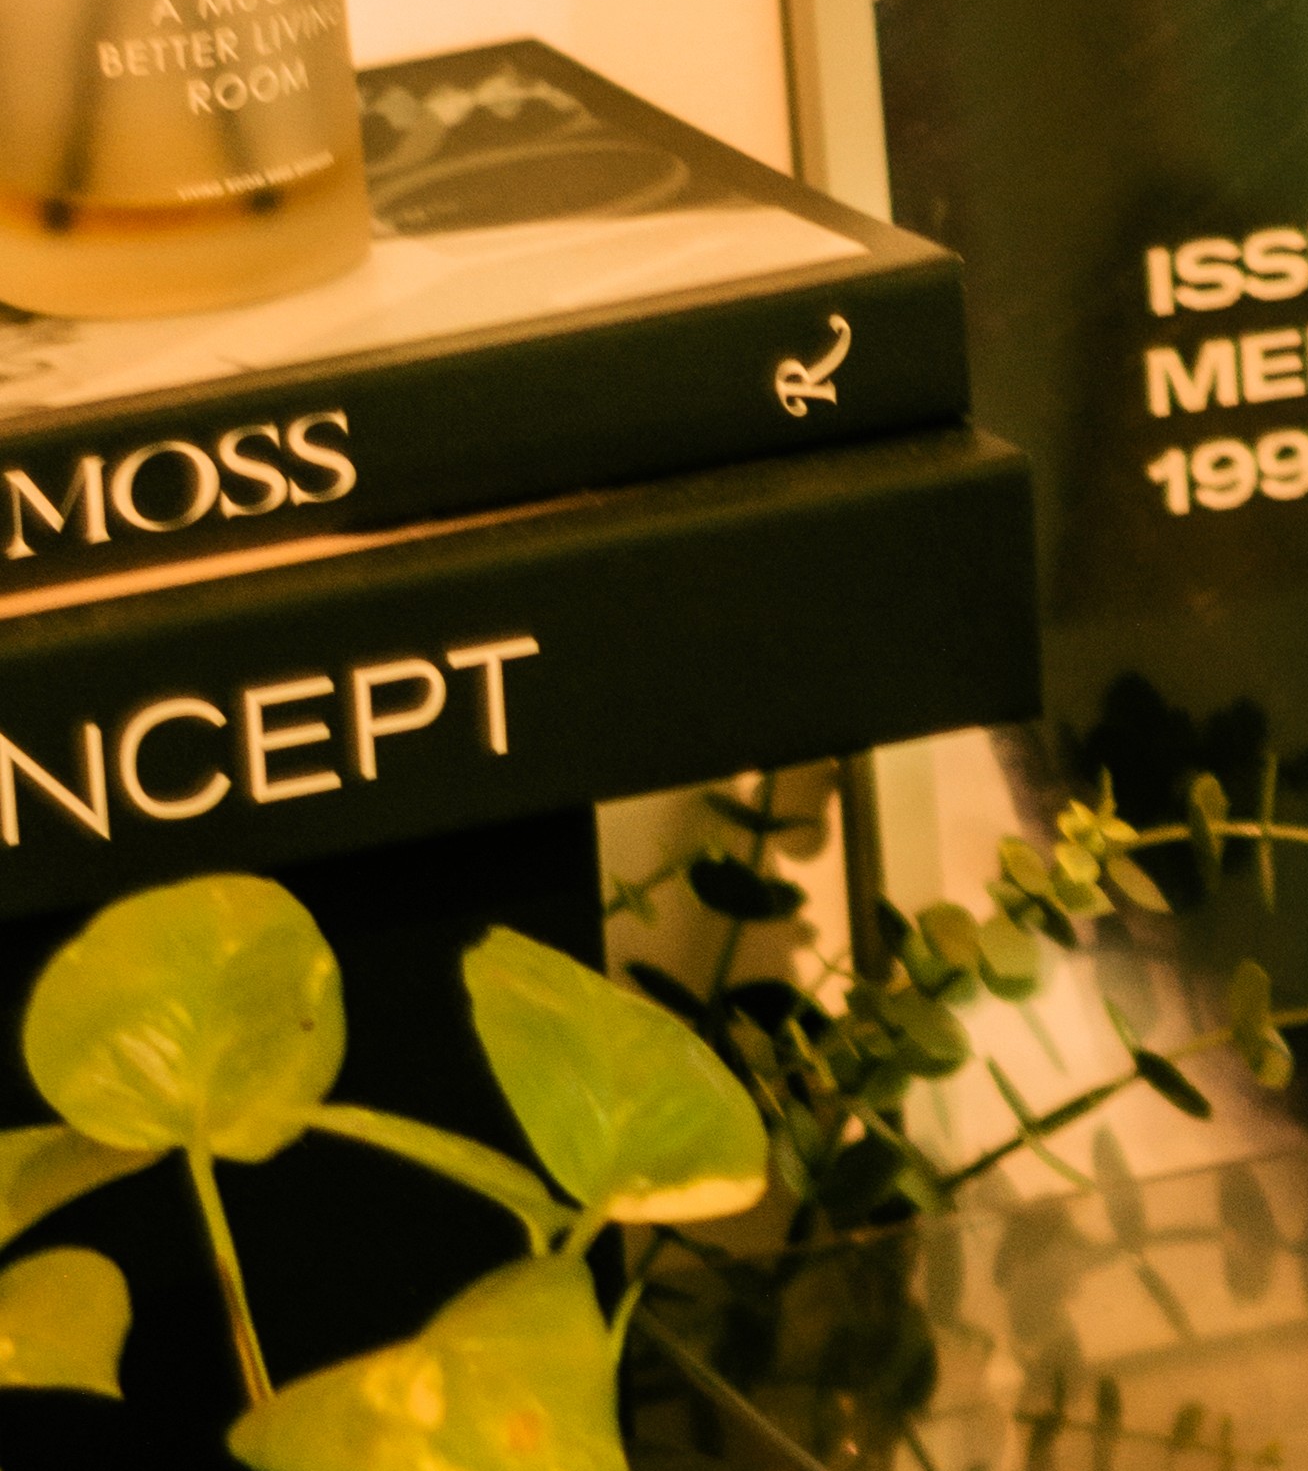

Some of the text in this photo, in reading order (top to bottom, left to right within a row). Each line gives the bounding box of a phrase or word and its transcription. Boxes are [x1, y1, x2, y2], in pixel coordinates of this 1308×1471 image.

[97, 26, 240, 79] BETTER
[186, 58, 310, 116] ROOM
[3, 409, 359, 560] MOSS
[0, 635, 540, 848] NCEPT
